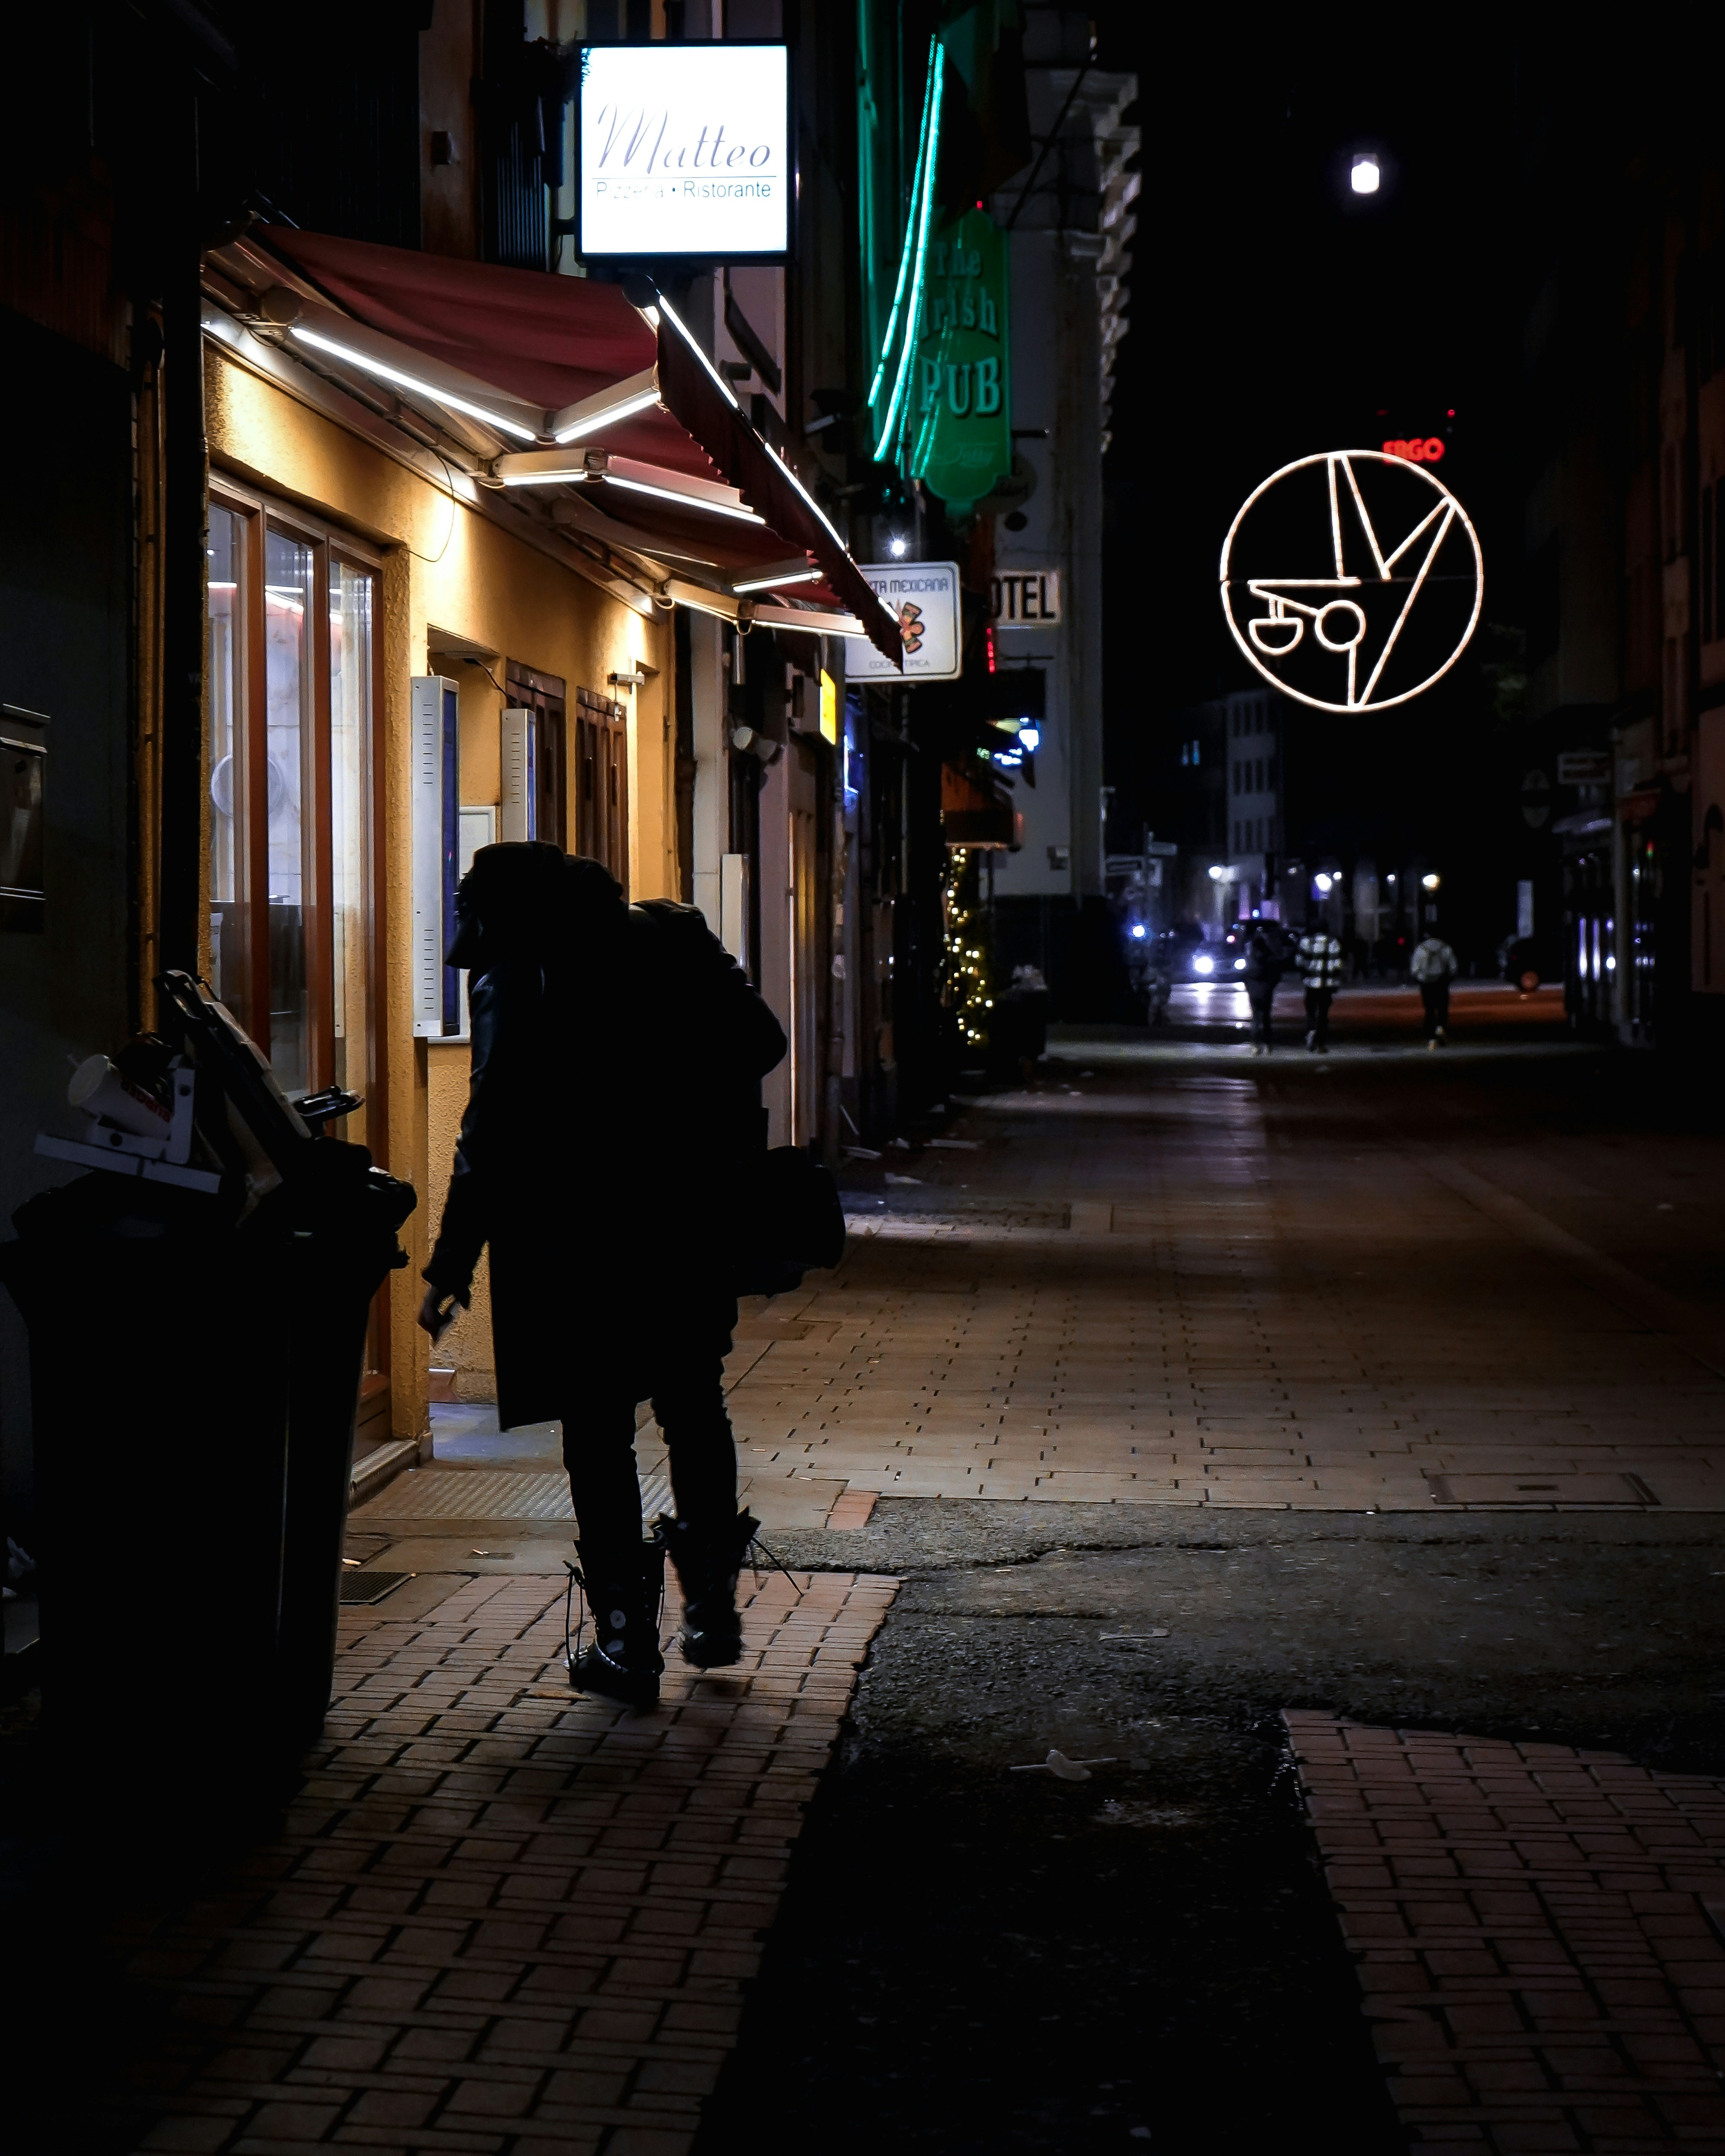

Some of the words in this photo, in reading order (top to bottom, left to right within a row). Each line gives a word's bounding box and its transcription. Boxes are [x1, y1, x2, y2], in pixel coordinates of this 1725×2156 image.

[598, 101, 770, 175] Matteo
[684, 181, 771, 198] Ristorante
[932, 241, 982, 276] The
[920, 356, 1000, 415] PUB
[890, 578, 948, 593] MEXICANA
[990, 576, 1055, 618] OTEL
